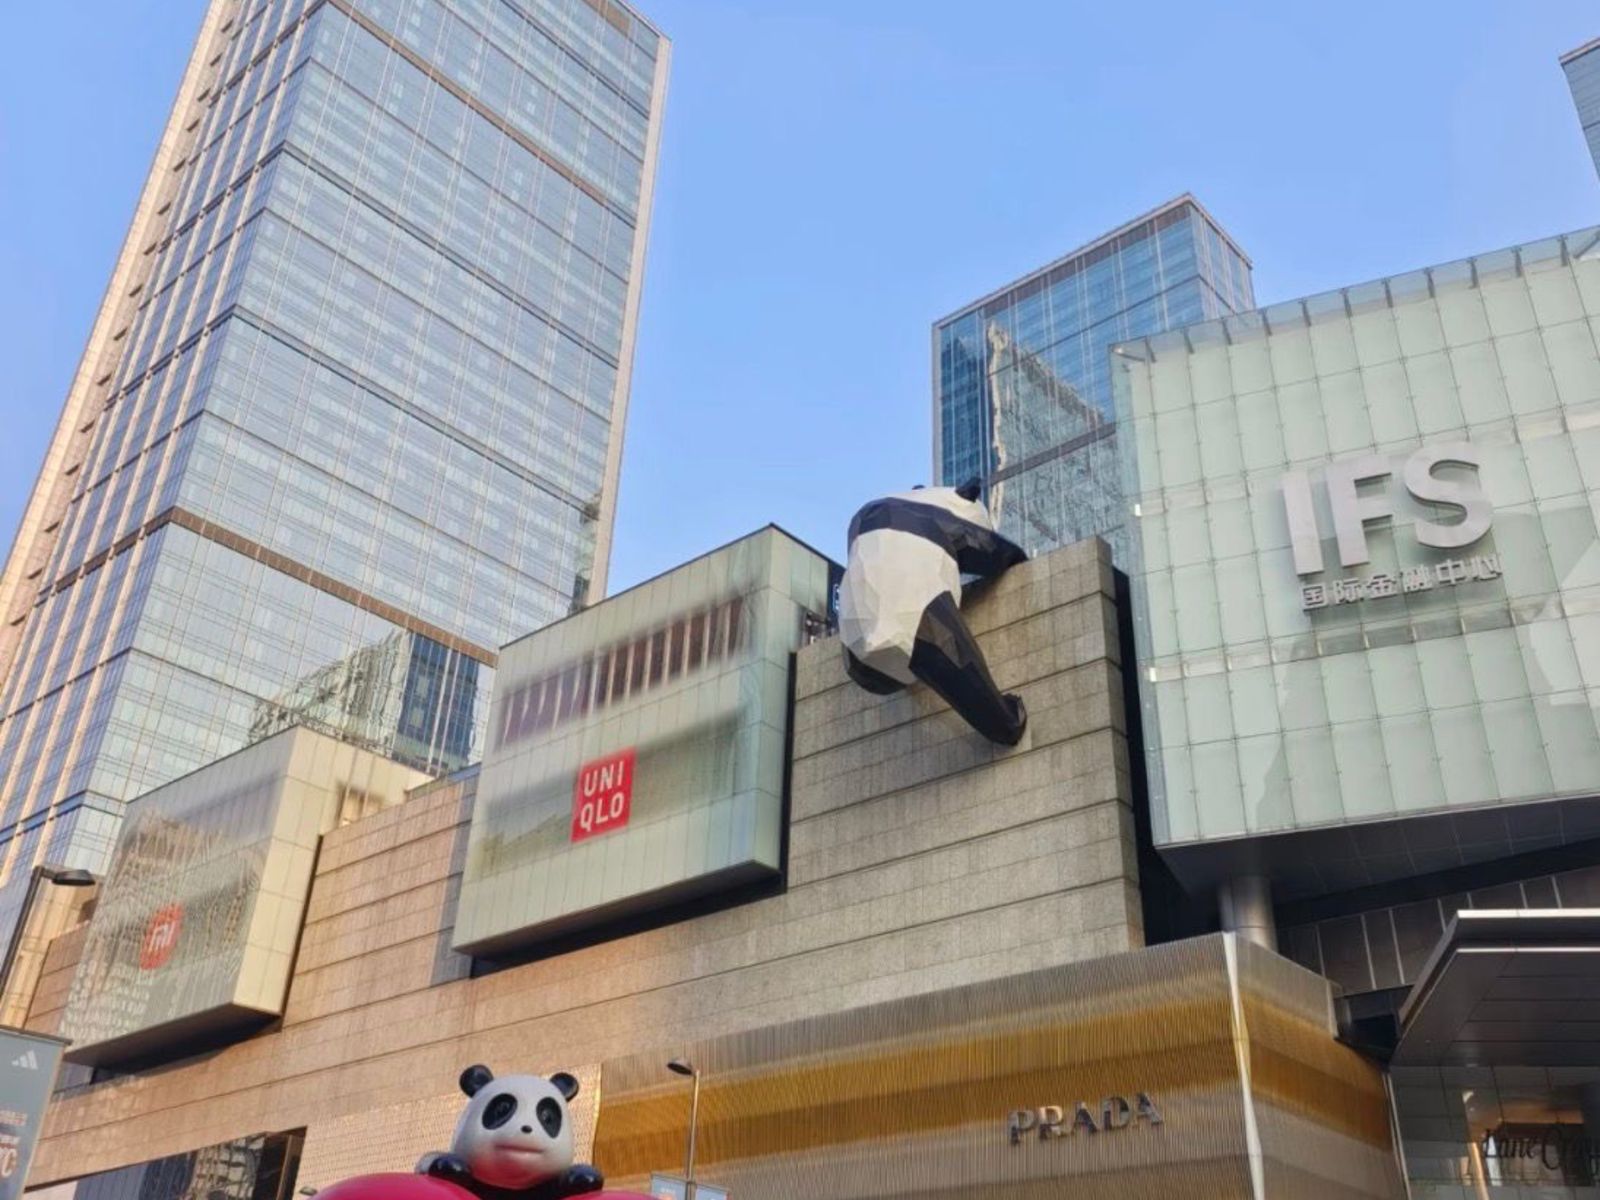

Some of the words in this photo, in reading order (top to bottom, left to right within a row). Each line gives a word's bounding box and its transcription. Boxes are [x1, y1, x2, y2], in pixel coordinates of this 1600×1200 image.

[1281, 441, 1493, 576] IFS
[1302, 553, 1502, 612] 国际金融中心
[584, 760, 624, 797] UNI
[580, 792, 624, 832] QLO
[1007, 1092, 1163, 1145] PRADA
